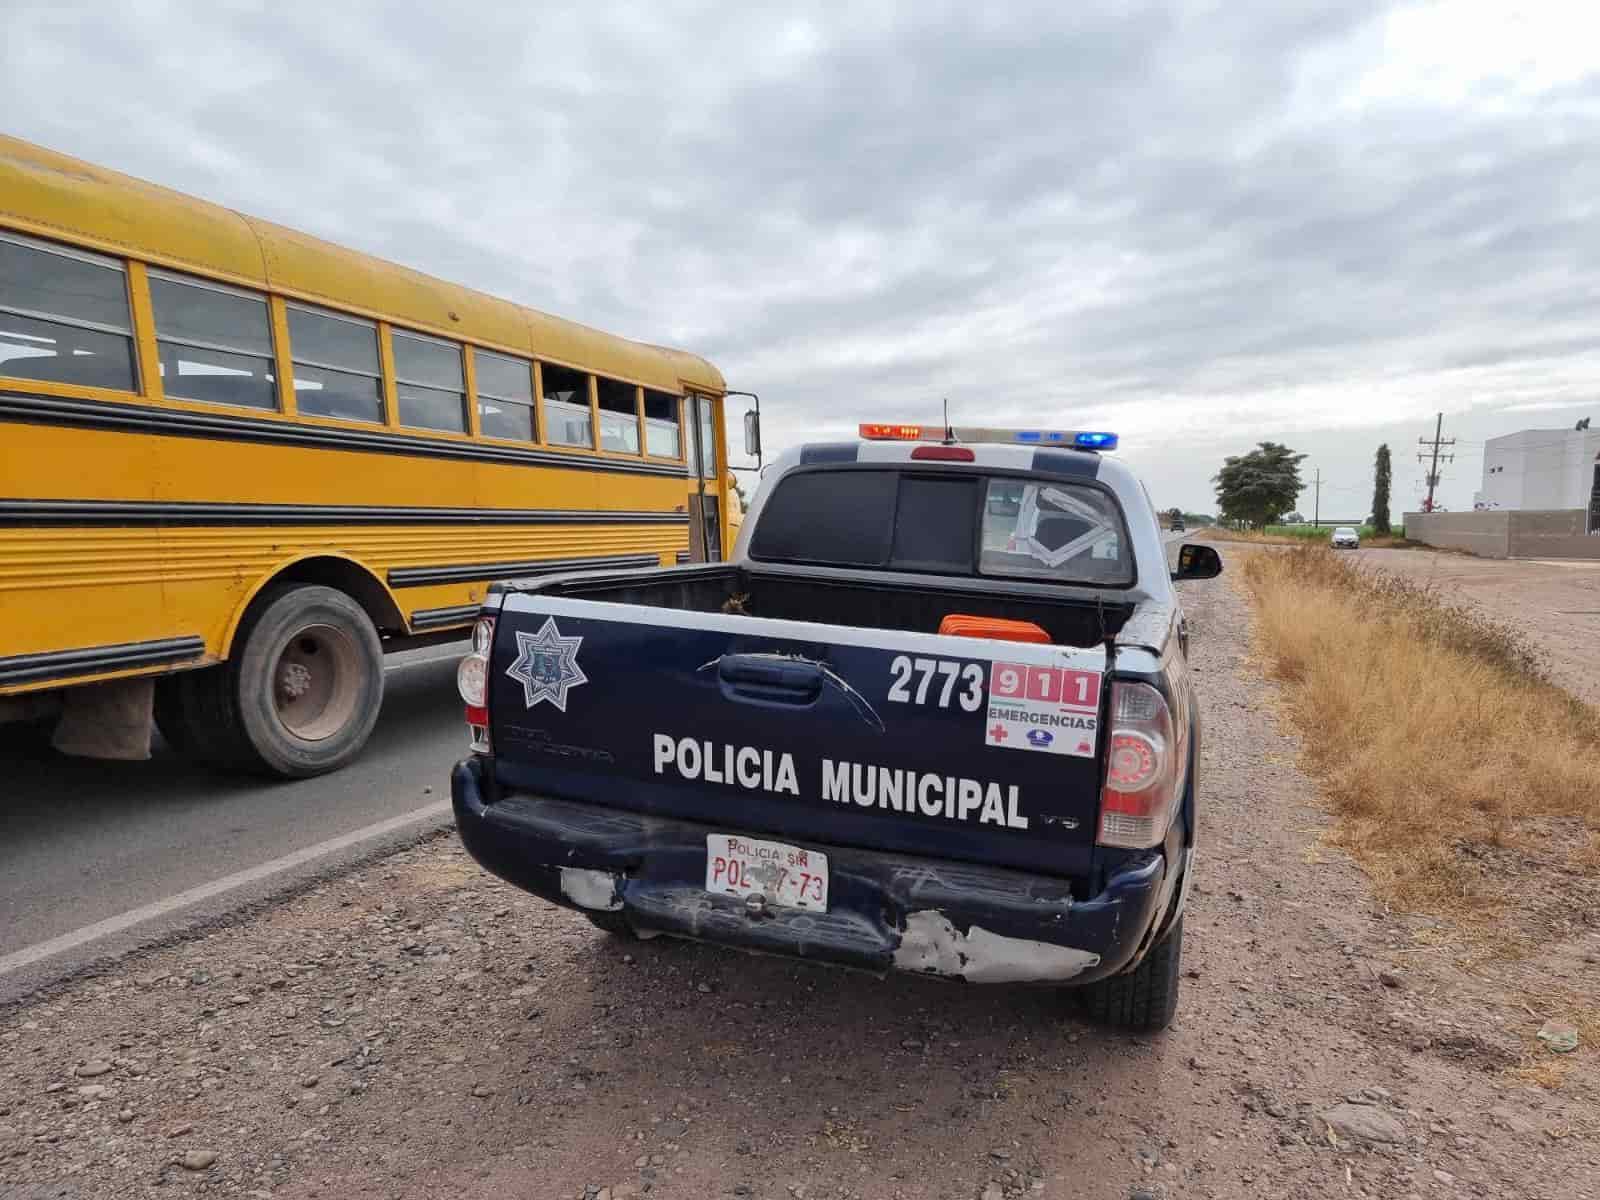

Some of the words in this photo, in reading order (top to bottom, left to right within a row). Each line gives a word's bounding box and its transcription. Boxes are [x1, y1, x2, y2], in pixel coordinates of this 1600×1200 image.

[887, 655, 985, 712] 2773
[988, 707, 1096, 730] EMERGENCIAS
[653, 733, 800, 795] POLICIA
[821, 759, 1029, 829] MUNICIPAL
[727, 839, 780, 861] POLICIA
[712, 857, 751, 889] POL
